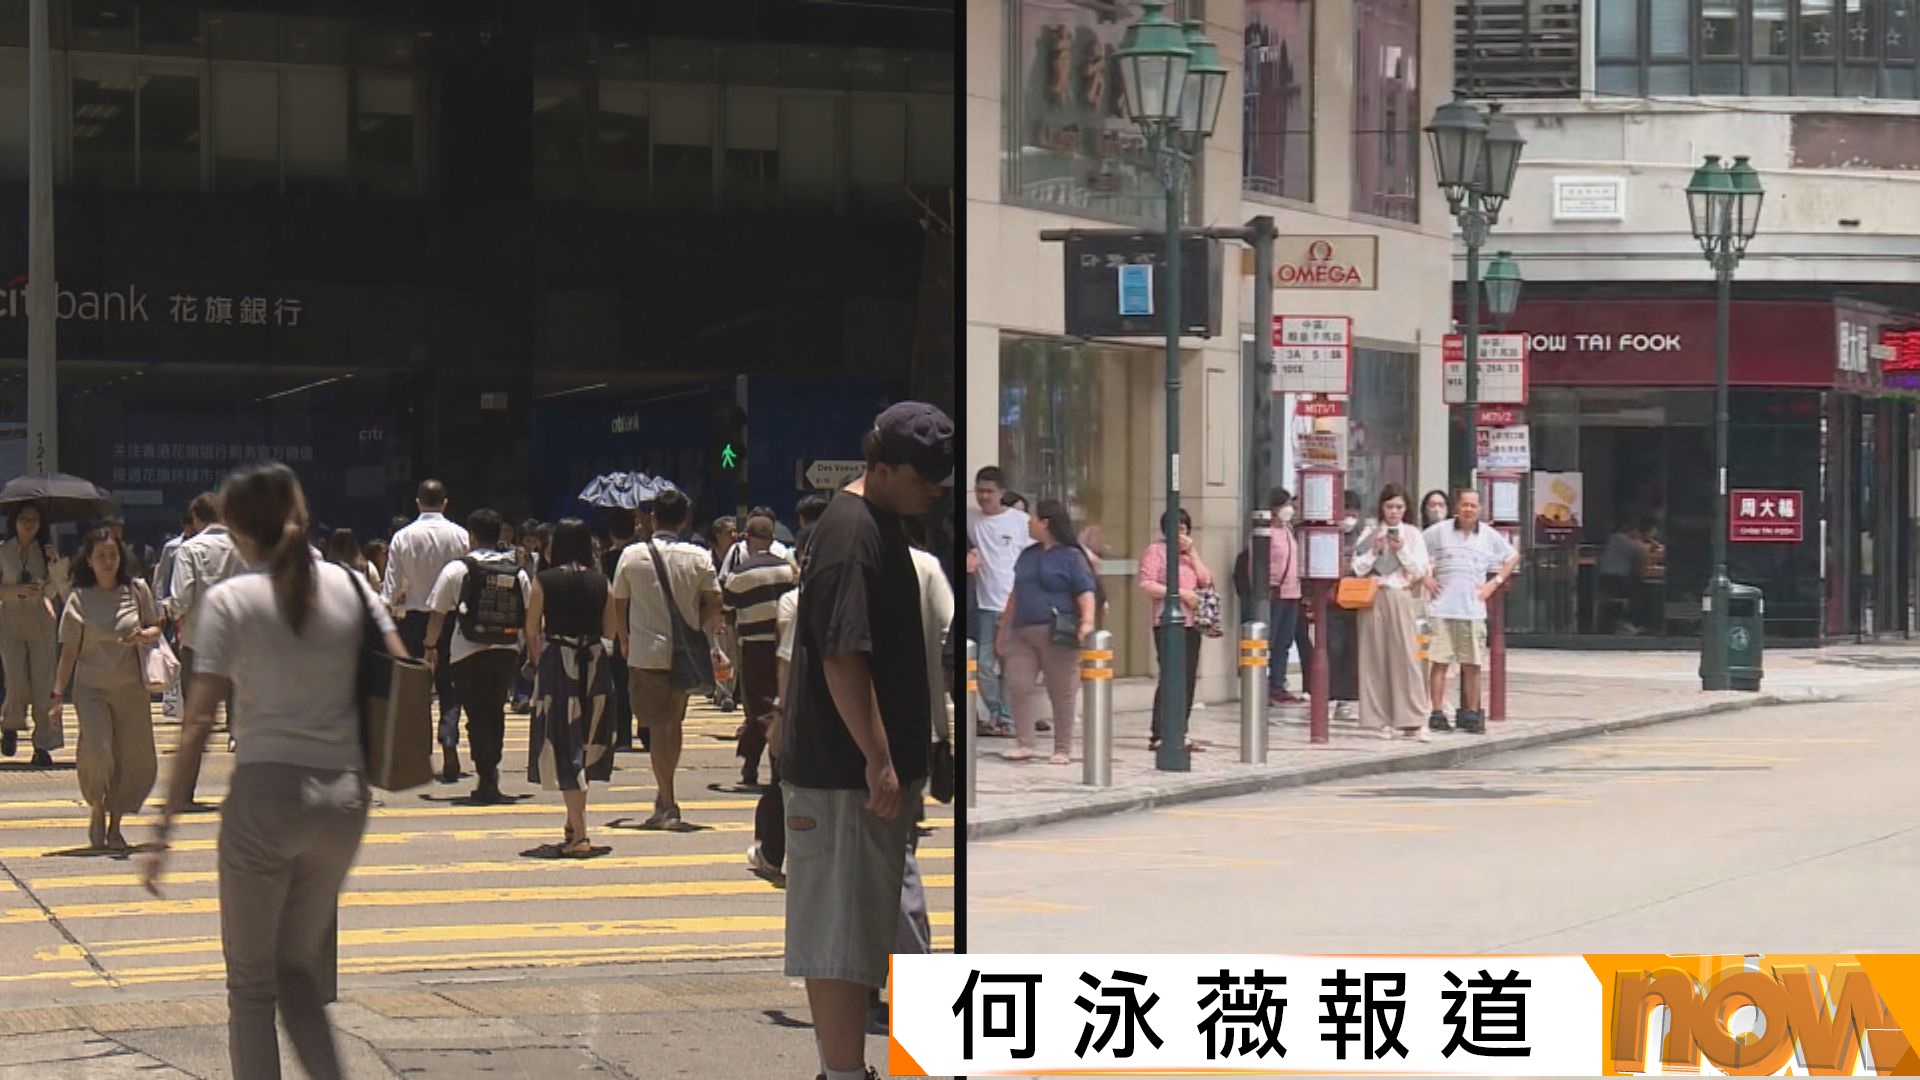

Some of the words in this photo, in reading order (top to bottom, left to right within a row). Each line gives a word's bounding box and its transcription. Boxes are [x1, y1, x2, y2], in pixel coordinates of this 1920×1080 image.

[1277, 264, 1361, 283] OMEGA
[168, 294, 303, 328] 花旗銀行
[1575, 334, 1611, 351] TAI
[1619, 334, 1681, 351] FOOK
[1739, 497, 1795, 518] 周大福
